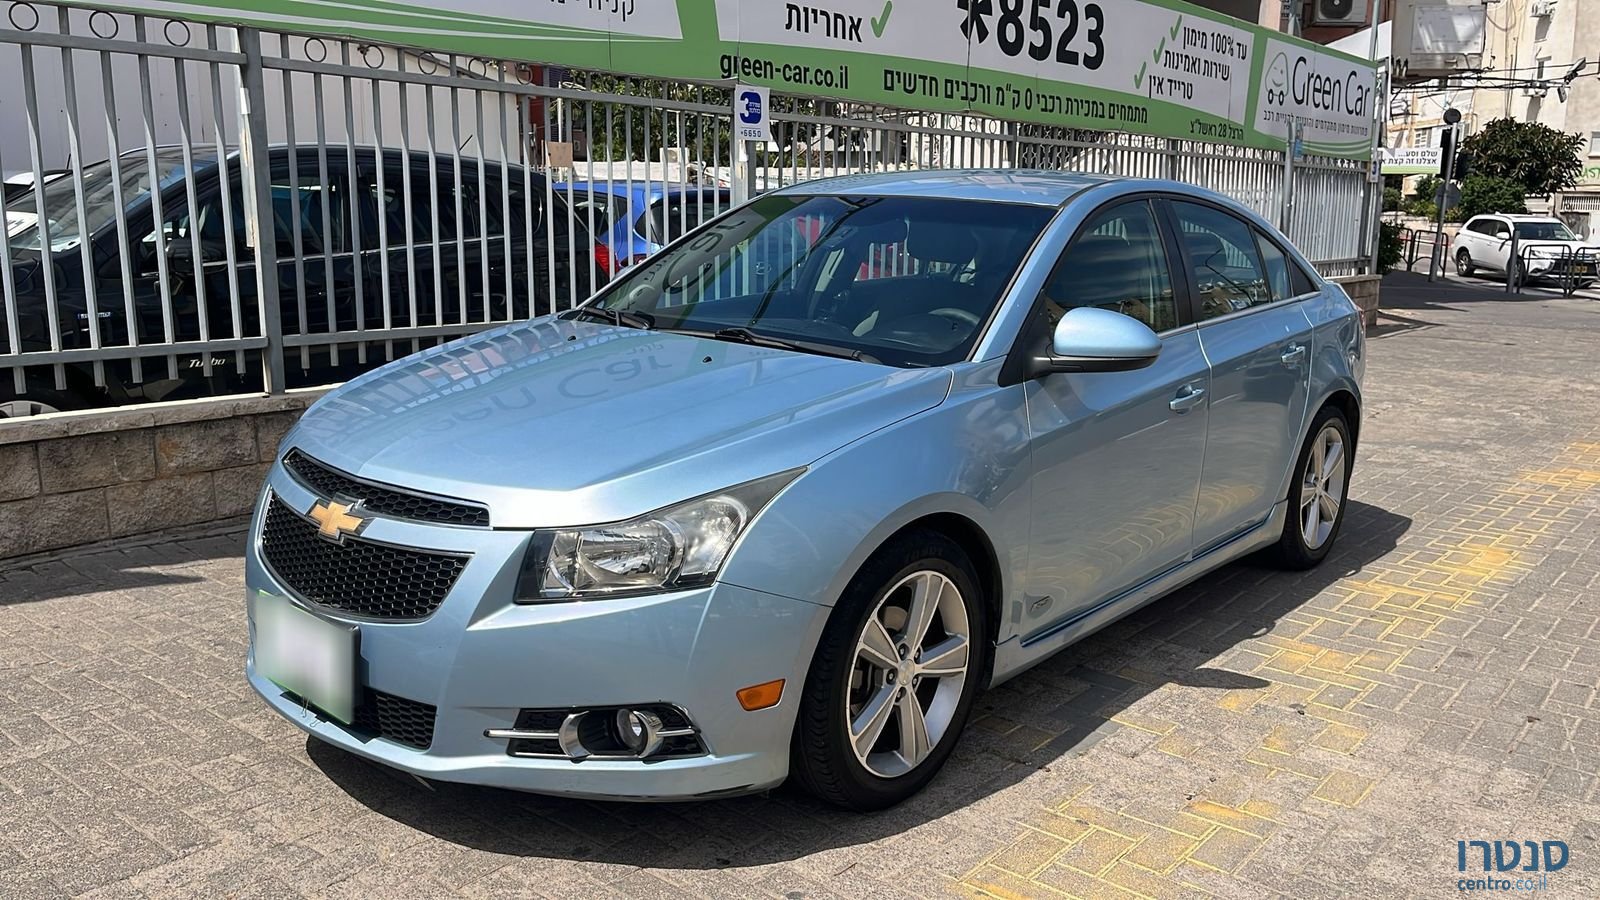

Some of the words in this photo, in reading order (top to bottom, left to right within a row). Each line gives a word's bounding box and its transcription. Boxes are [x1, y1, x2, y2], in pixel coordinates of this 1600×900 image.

[785, 3, 862, 42] אחריות
[1183, 27, 1207, 49] מימון
[1211, 32, 1234, 56] 100%
[1164, 50, 1201, 75] ואמינות
[1236, 43, 1247, 60] עד
[720, 53, 848, 89] green-car.co.il
[1203, 60, 1230, 81] שירות
[883, 69, 938, 97] חדשים
[944, 79, 991, 104] ורכבים
[1149, 75, 1164, 99] אין
[1167, 78, 1193, 100] טרייד
[1292, 56, 1341, 112] Green
[1345, 70, 1370, 117] Car
[1025, 87, 1033, 110] 0
[1036, 93, 1062, 114] רכבי
[1065, 97, 1105, 119] במכירת
[1108, 103, 1147, 123] מתמחים
[1218, 122, 1227, 138] 28
[1229, 124, 1244, 140] הרצל
[1388, 158, 1404, 166] קצת
[1416, 157, 1437, 165] אצלנו
[189, 357, 226, 368] Tubo
